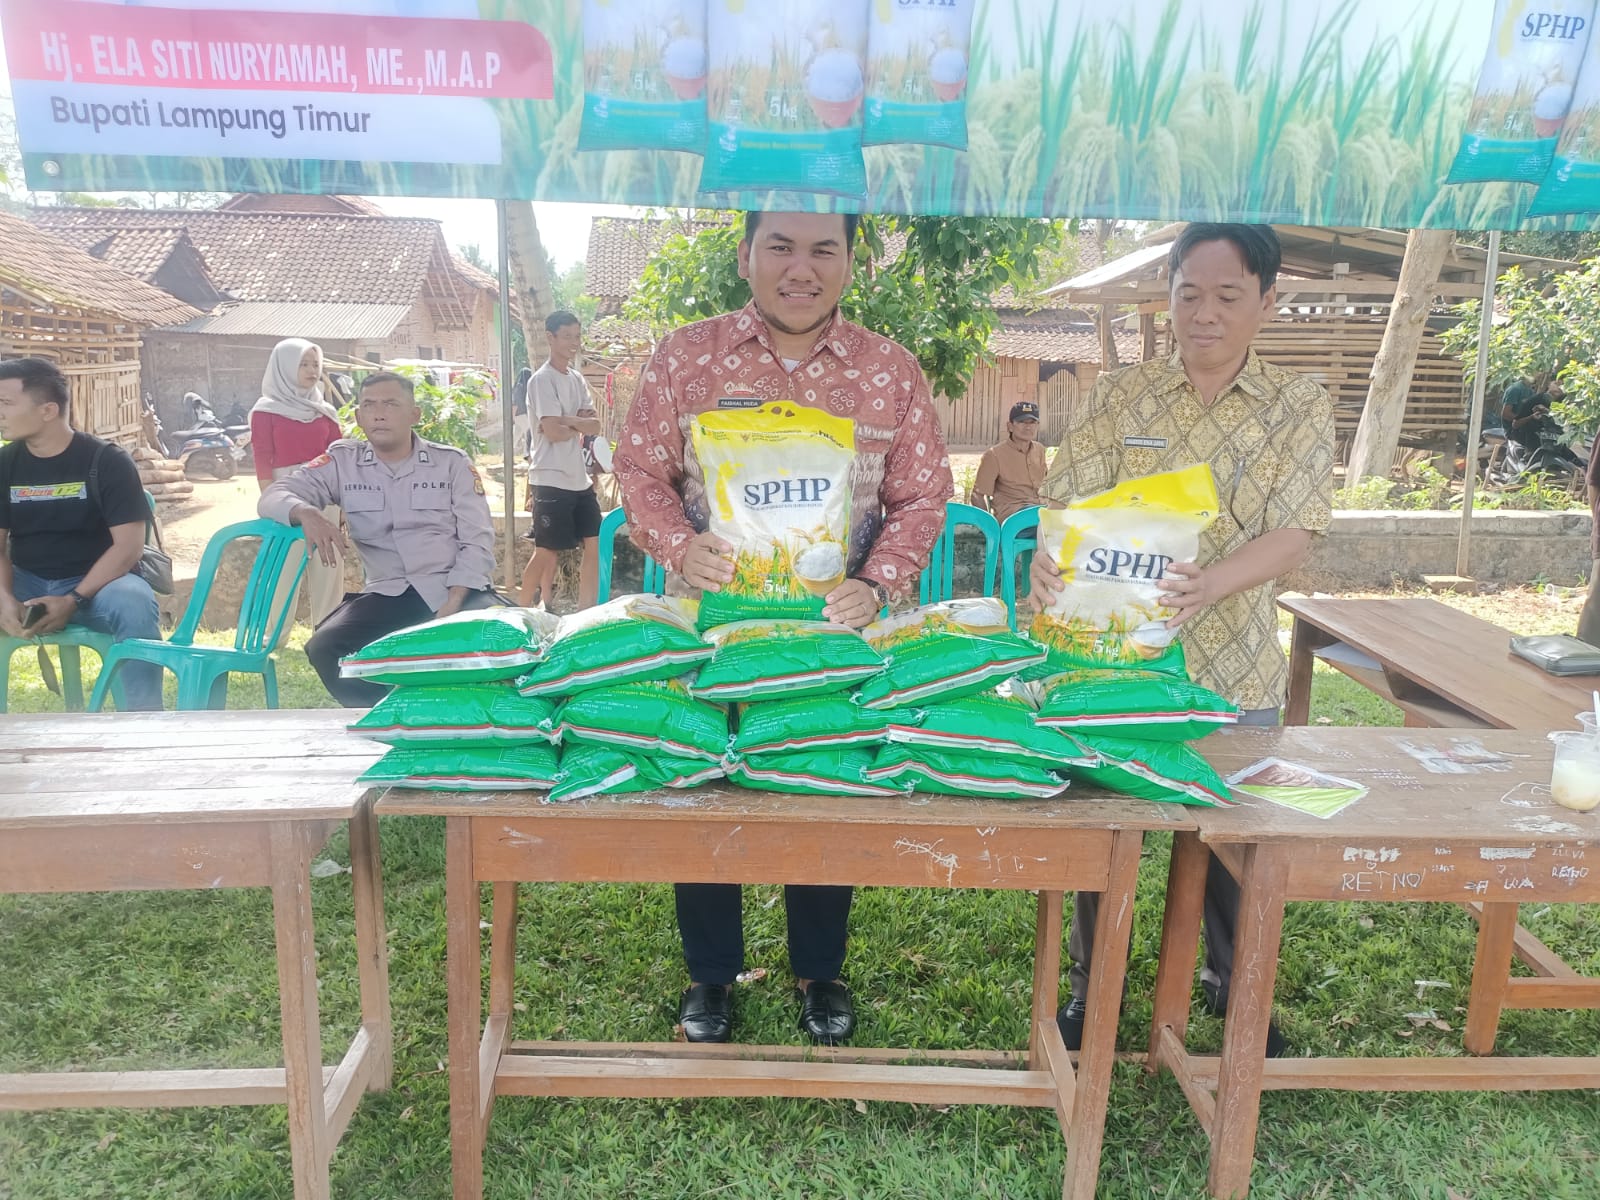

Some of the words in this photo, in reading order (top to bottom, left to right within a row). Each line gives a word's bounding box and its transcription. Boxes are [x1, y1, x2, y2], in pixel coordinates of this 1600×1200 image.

[1521, 12, 1585, 40] SPHP
[40, 31, 82, 82] Hj.
[89, 35, 146, 77] ELA
[151, 39, 203, 80] SITI
[208, 42, 357, 92] NURYAMAH,
[50, 96, 150, 133] Bupati
[157, 101, 286, 139] Lampung
[293, 104, 371, 133] Timur
[413, 481, 451, 490] POLRI
[744, 478, 831, 506] SPHP
[763, 579, 774, 593] 5
[1093, 639, 1104, 654] 5
